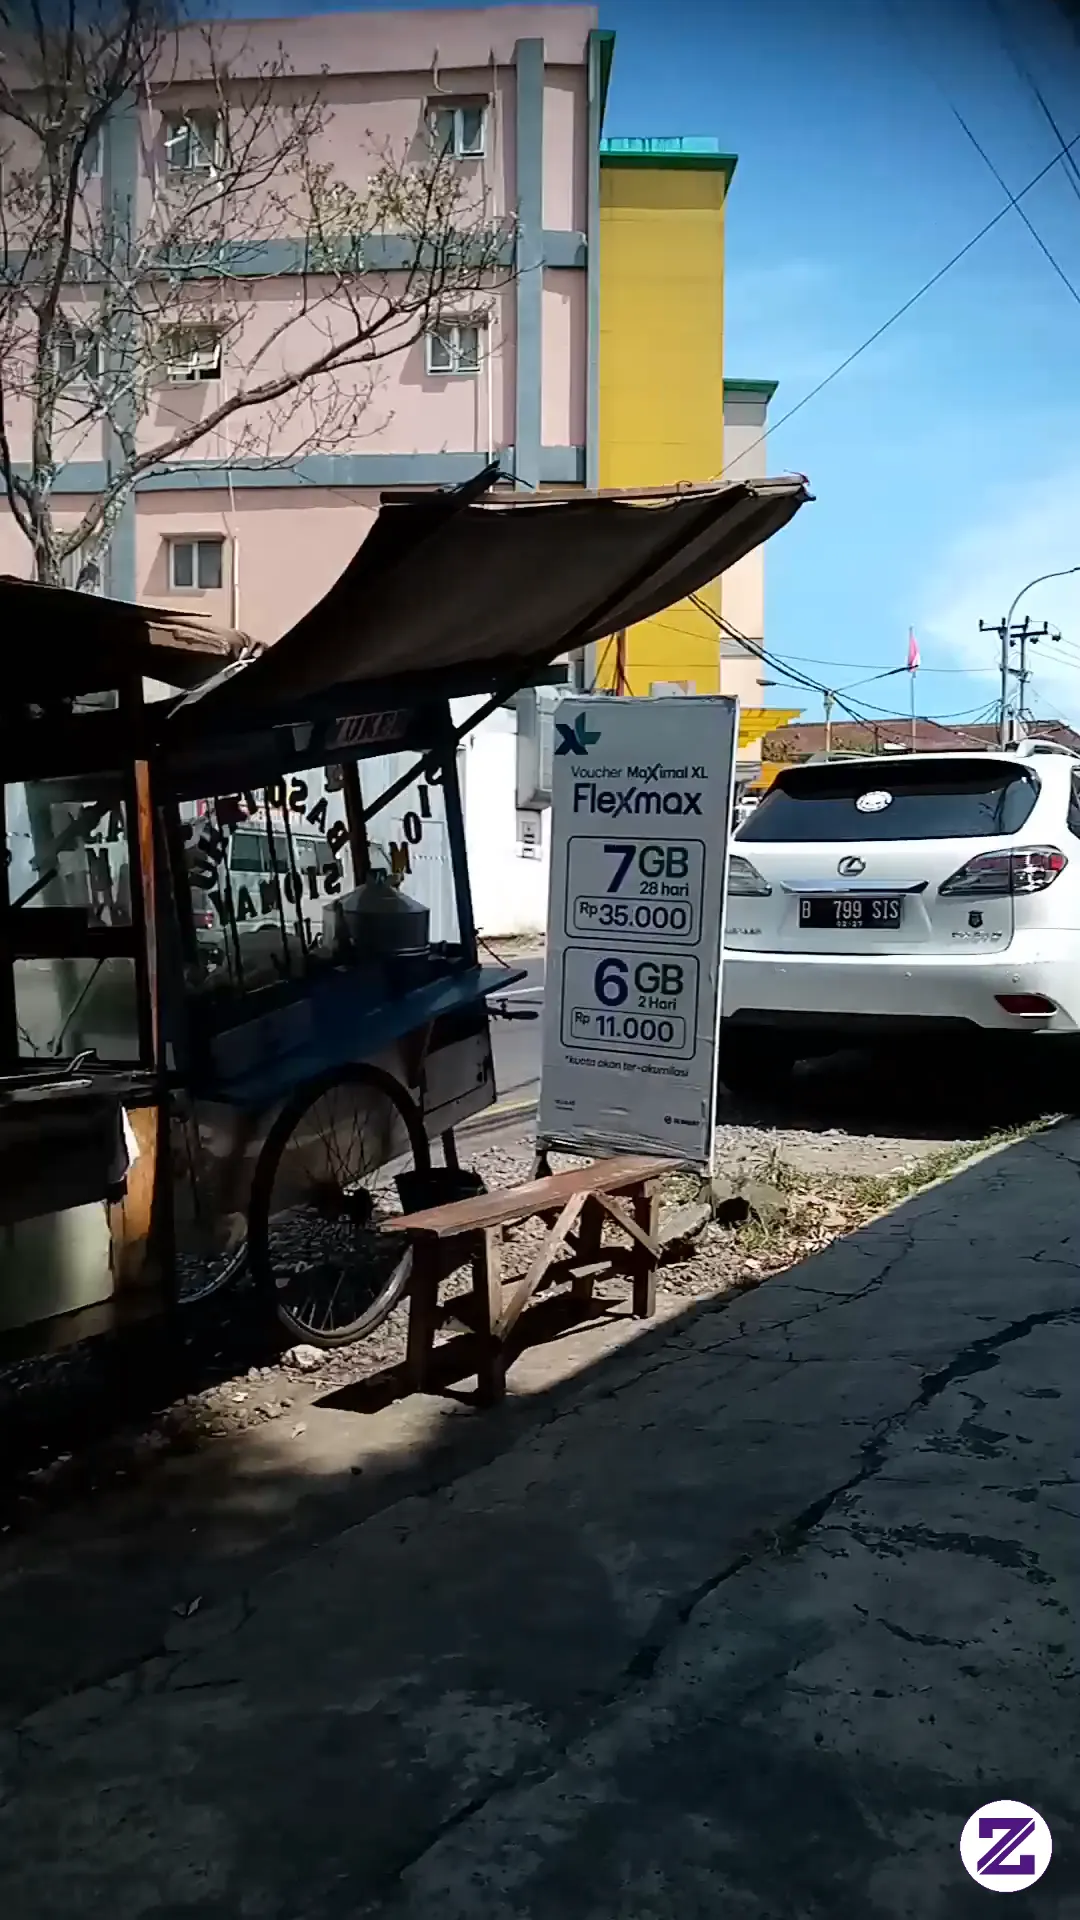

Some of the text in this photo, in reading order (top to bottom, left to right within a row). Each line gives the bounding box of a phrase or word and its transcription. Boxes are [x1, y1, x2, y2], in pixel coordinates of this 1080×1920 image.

[571, 764, 623, 779] Voucher
[691, 766, 709, 780] XL
[639, 881, 690, 897] 28 hari
[801, 900, 900, 920] B 799 SIS
[594, 957, 684, 1007] 6 GB
[638, 995, 677, 1011] 2 Hari
[574, 1011, 675, 1043] Rp 11.000
